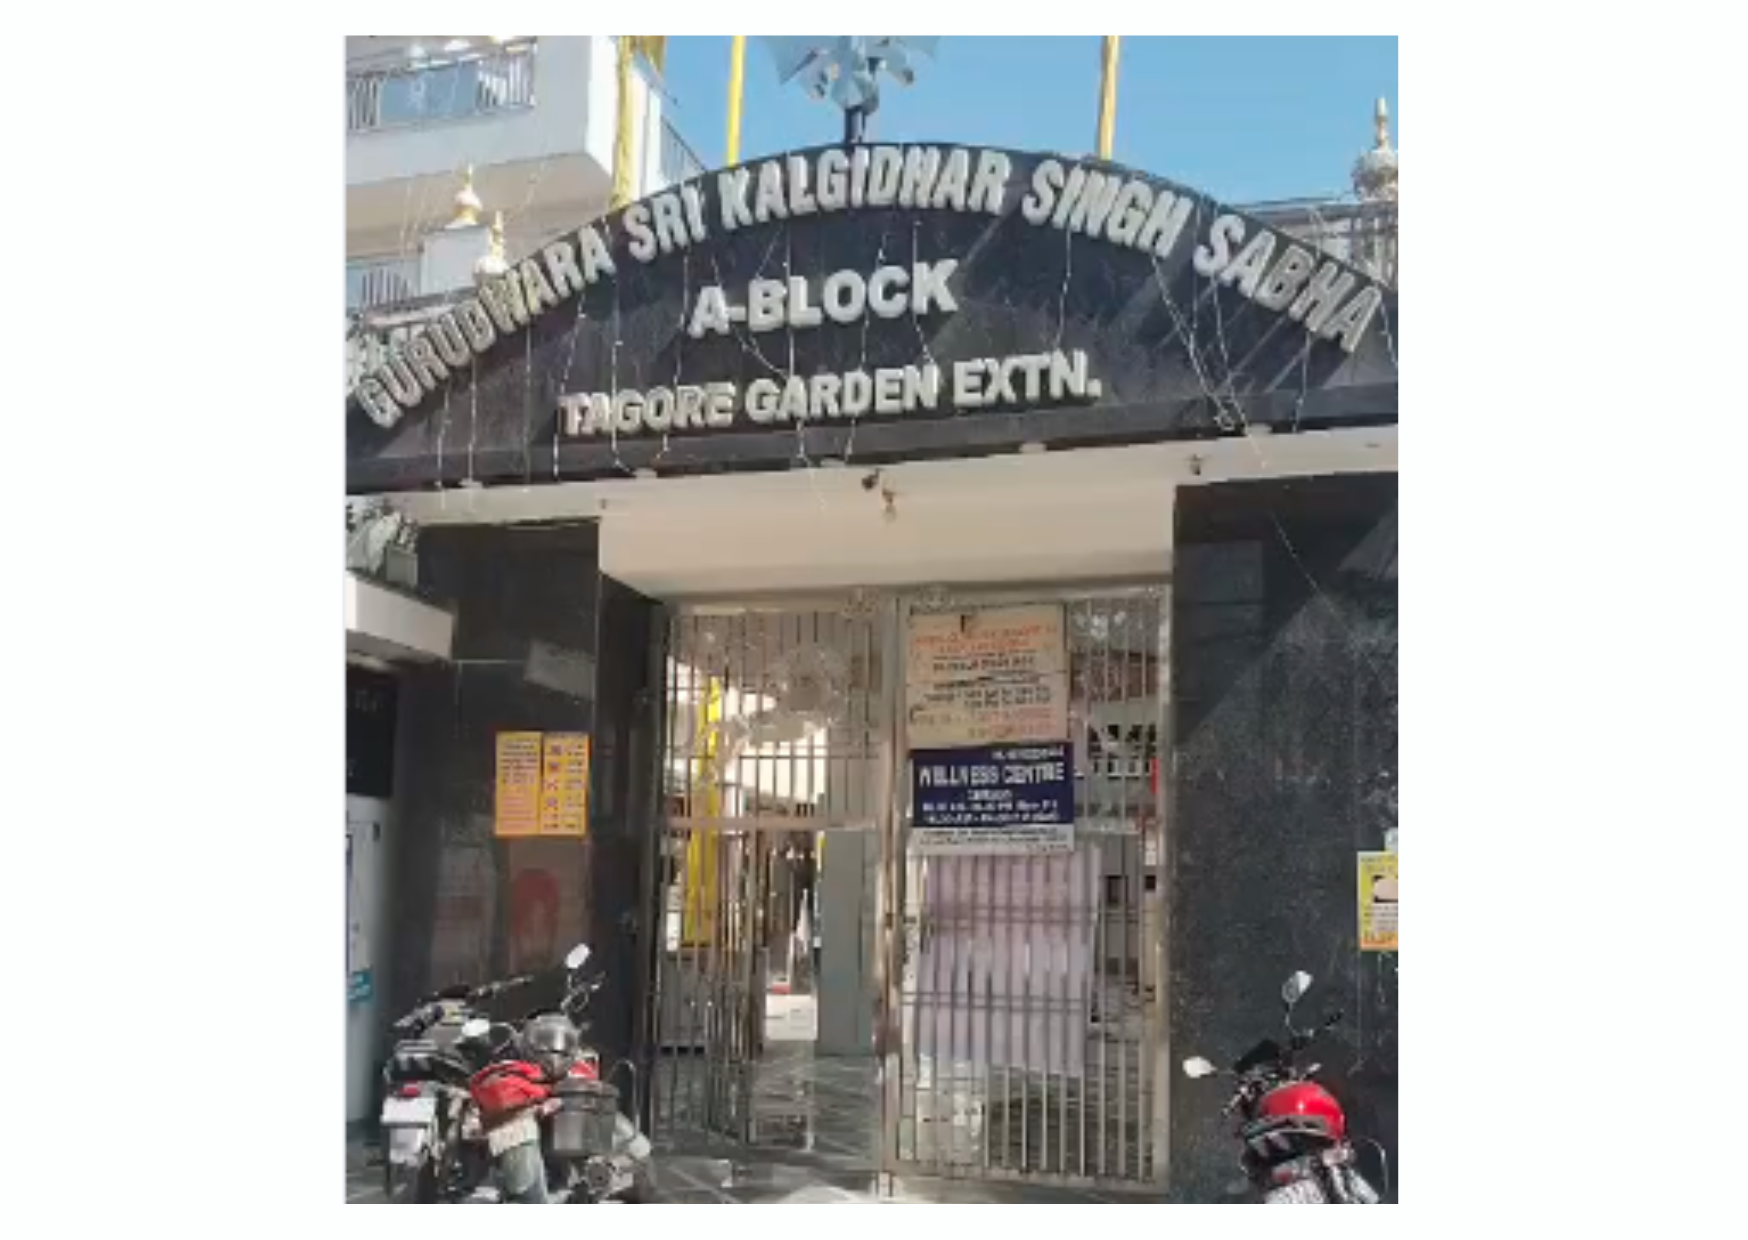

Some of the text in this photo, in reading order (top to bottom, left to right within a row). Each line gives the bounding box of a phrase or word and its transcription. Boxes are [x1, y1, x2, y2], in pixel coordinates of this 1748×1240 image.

[354, 145, 1383, 429] GURUDWARA SRI KALGIDHAR SINGH SABHA
[687, 258, 959, 338] A-BLOCK
[558, 348, 1101, 435] TAGORE GARDEN EXTN.
